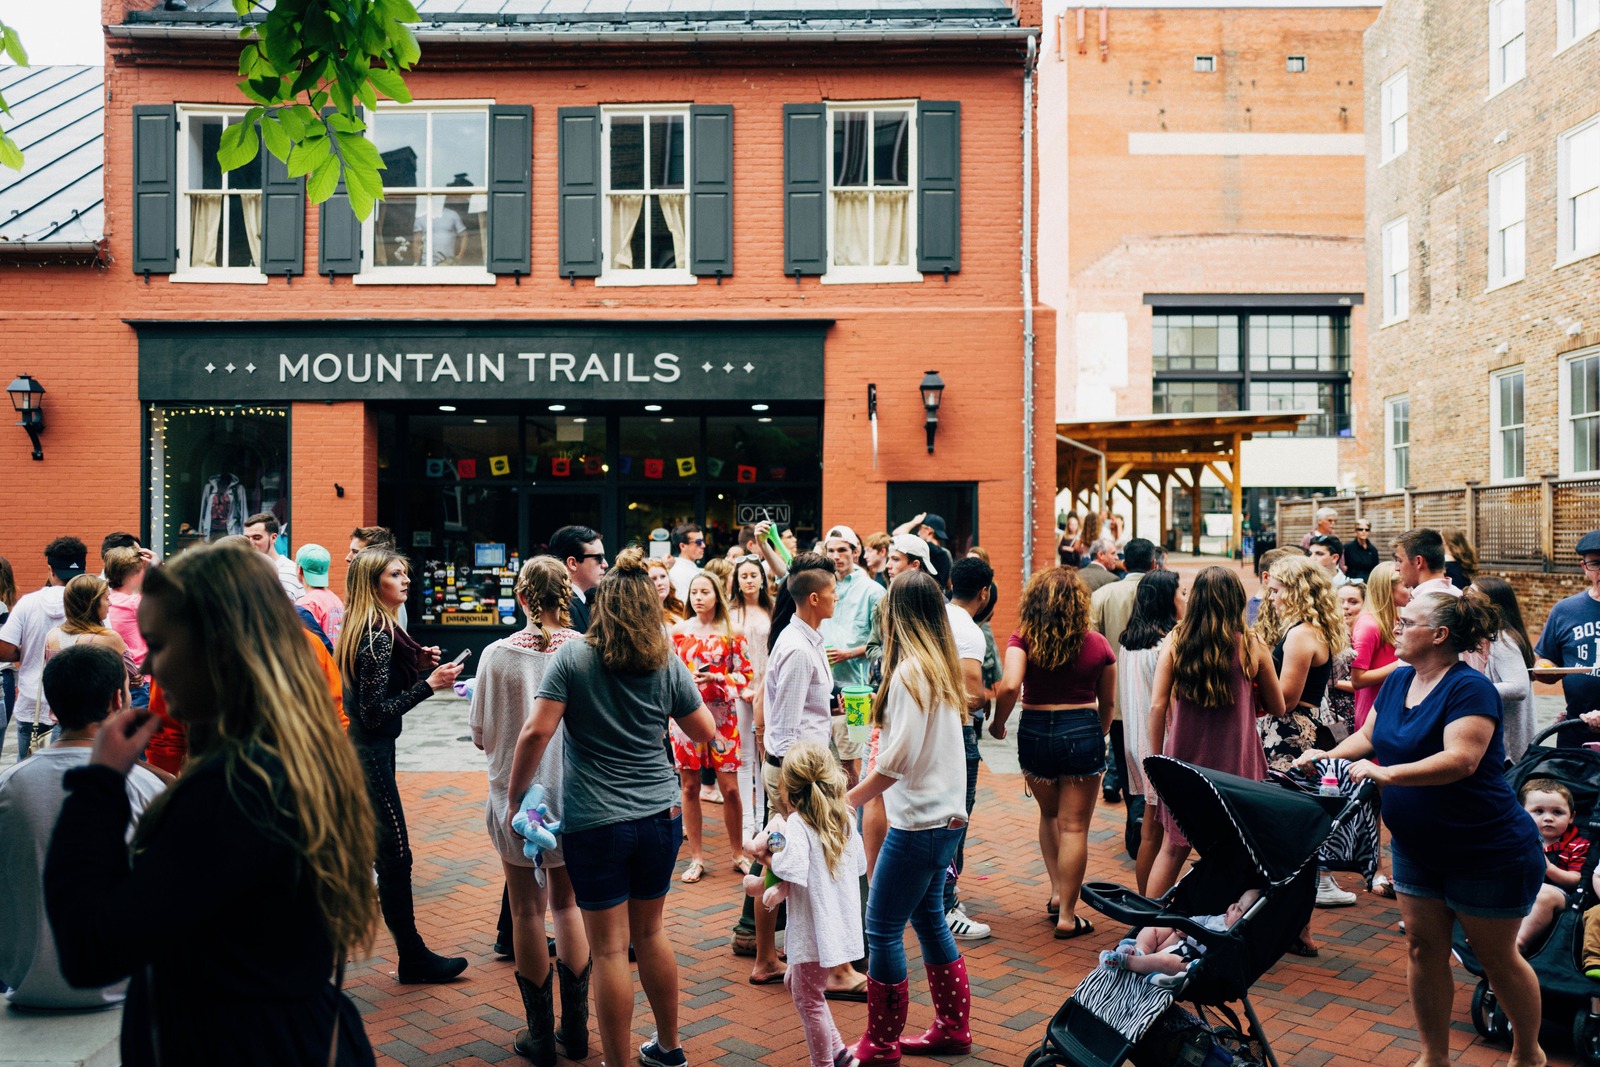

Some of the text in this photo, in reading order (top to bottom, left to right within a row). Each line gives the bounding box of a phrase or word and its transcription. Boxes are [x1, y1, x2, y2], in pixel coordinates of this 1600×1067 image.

[279, 353, 681, 383] MOUNTAIN TRAILS
[741, 506, 788, 522] OPEN
[446, 615, 488, 623] patagonia
[1577, 644, 1588, 660] 16
